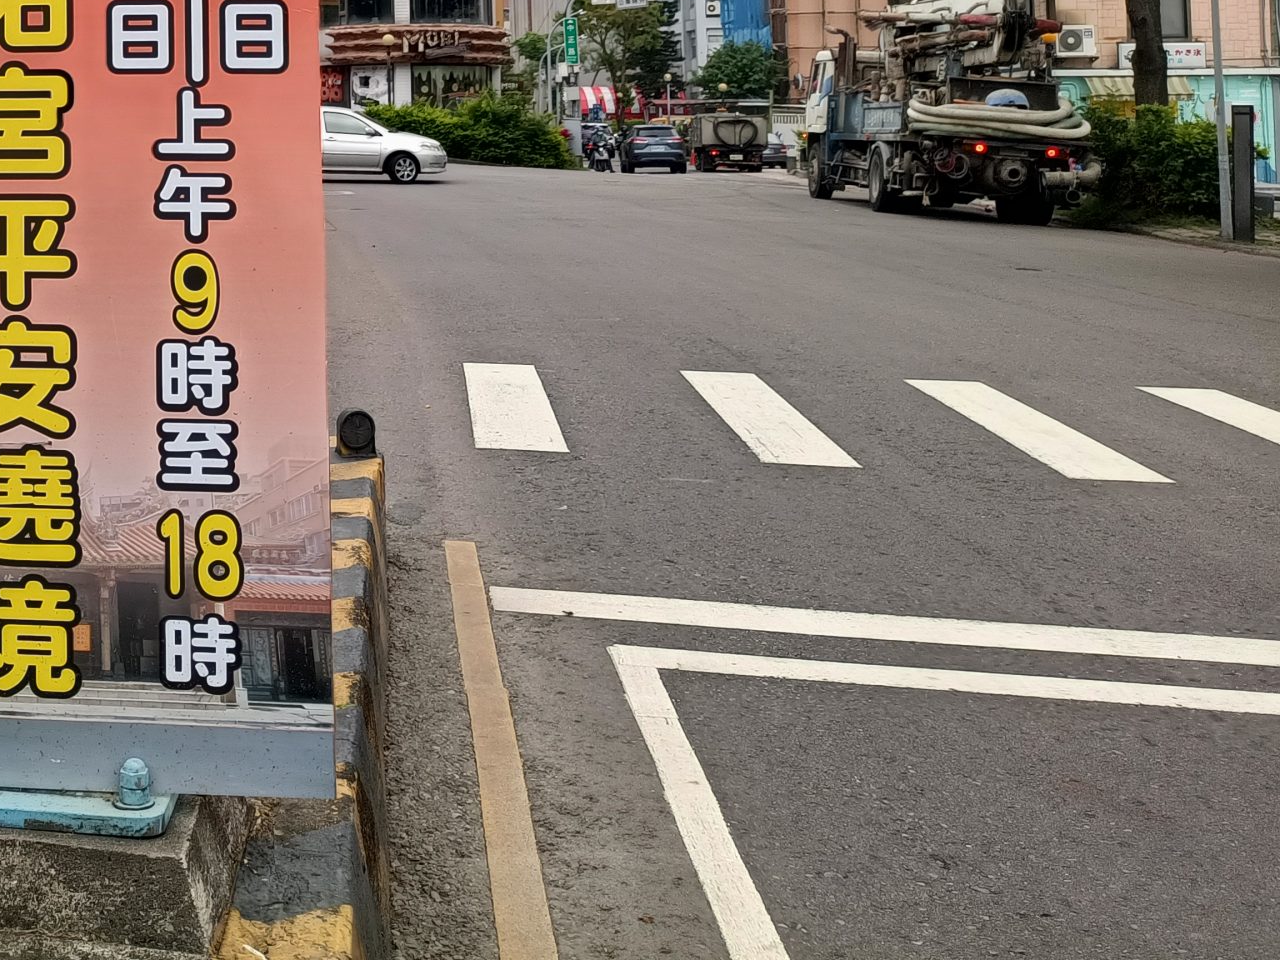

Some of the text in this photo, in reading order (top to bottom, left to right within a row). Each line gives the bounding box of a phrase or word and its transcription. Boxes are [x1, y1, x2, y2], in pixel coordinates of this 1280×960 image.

[151, 84, 244, 694] 上午9時至18時
